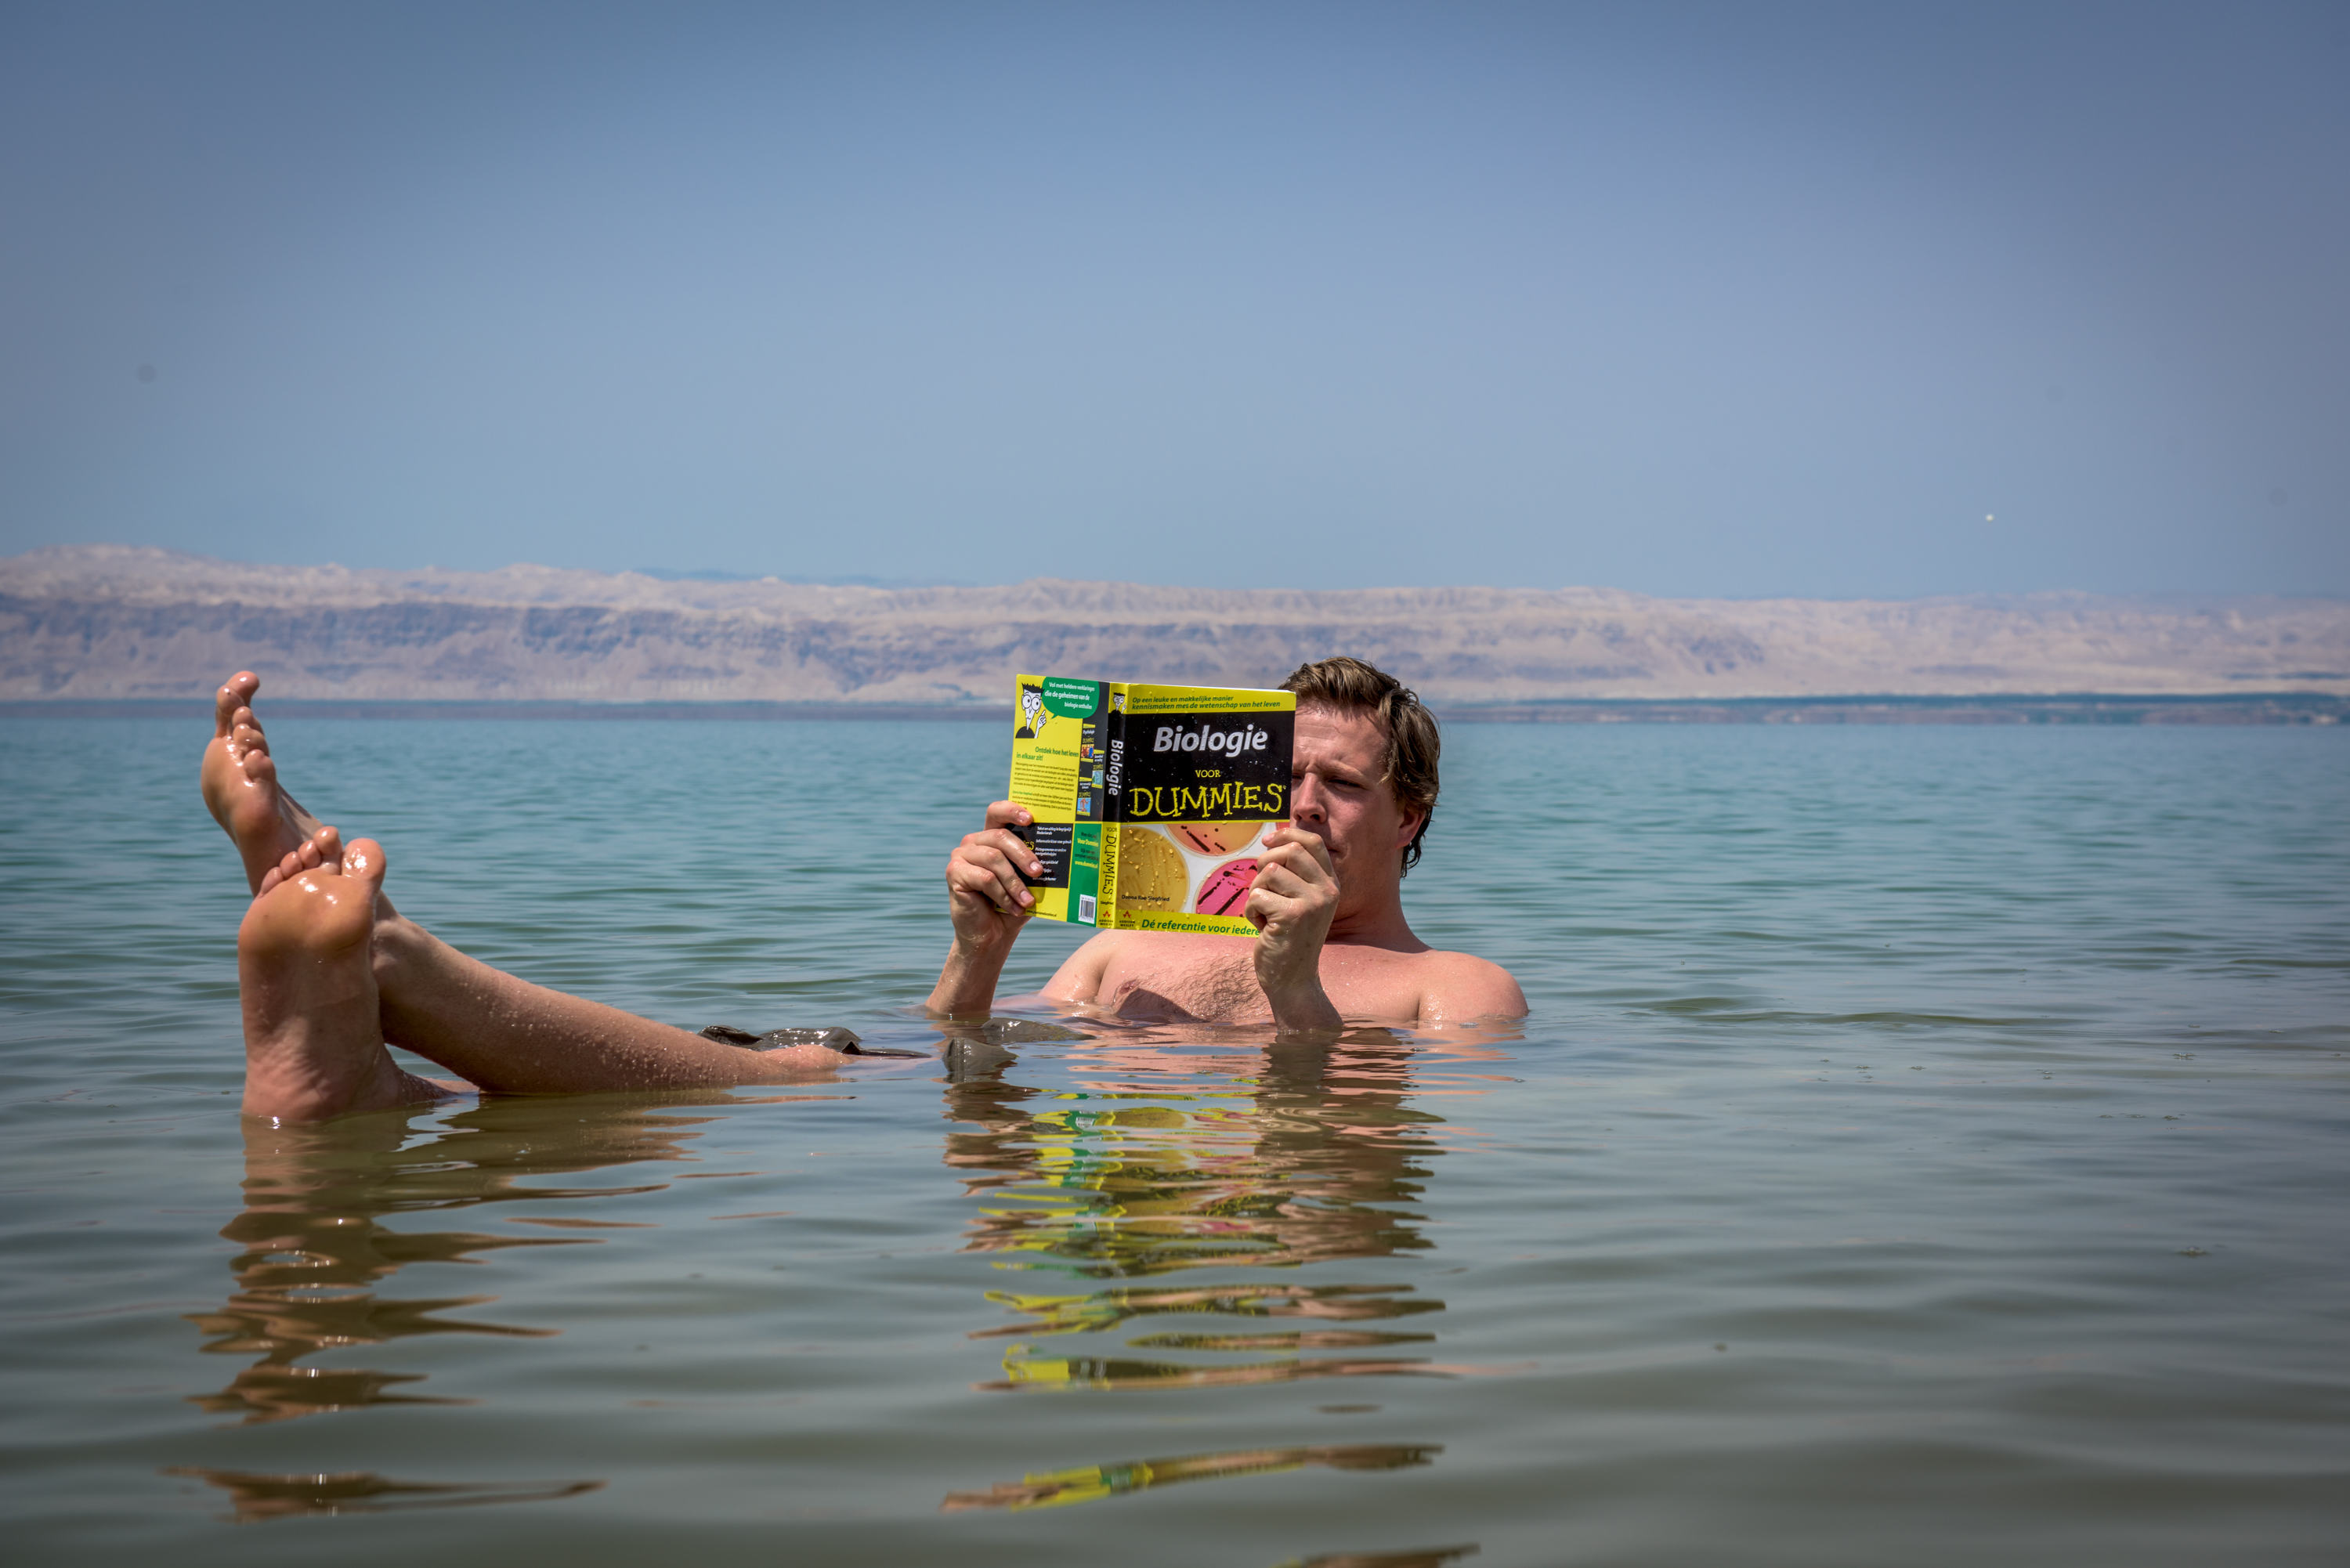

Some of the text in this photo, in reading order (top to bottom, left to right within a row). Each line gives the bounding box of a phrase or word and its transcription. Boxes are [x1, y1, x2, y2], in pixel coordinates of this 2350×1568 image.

[1198, 701, 1238, 710] wetenschap
[1153, 724, 1268, 757] Biologie
[1106, 739, 1123, 796] Biologie
[1195, 769, 1221, 778] VOOR
[1129, 781, 1283, 818] DUMMIES
[1102, 834, 1117, 894] DUMMIES
[1141, 919, 1155, 928] Dé
[1157, 919, 1206, 931] referentie
[1231, 925, 1260, 936] iedere
